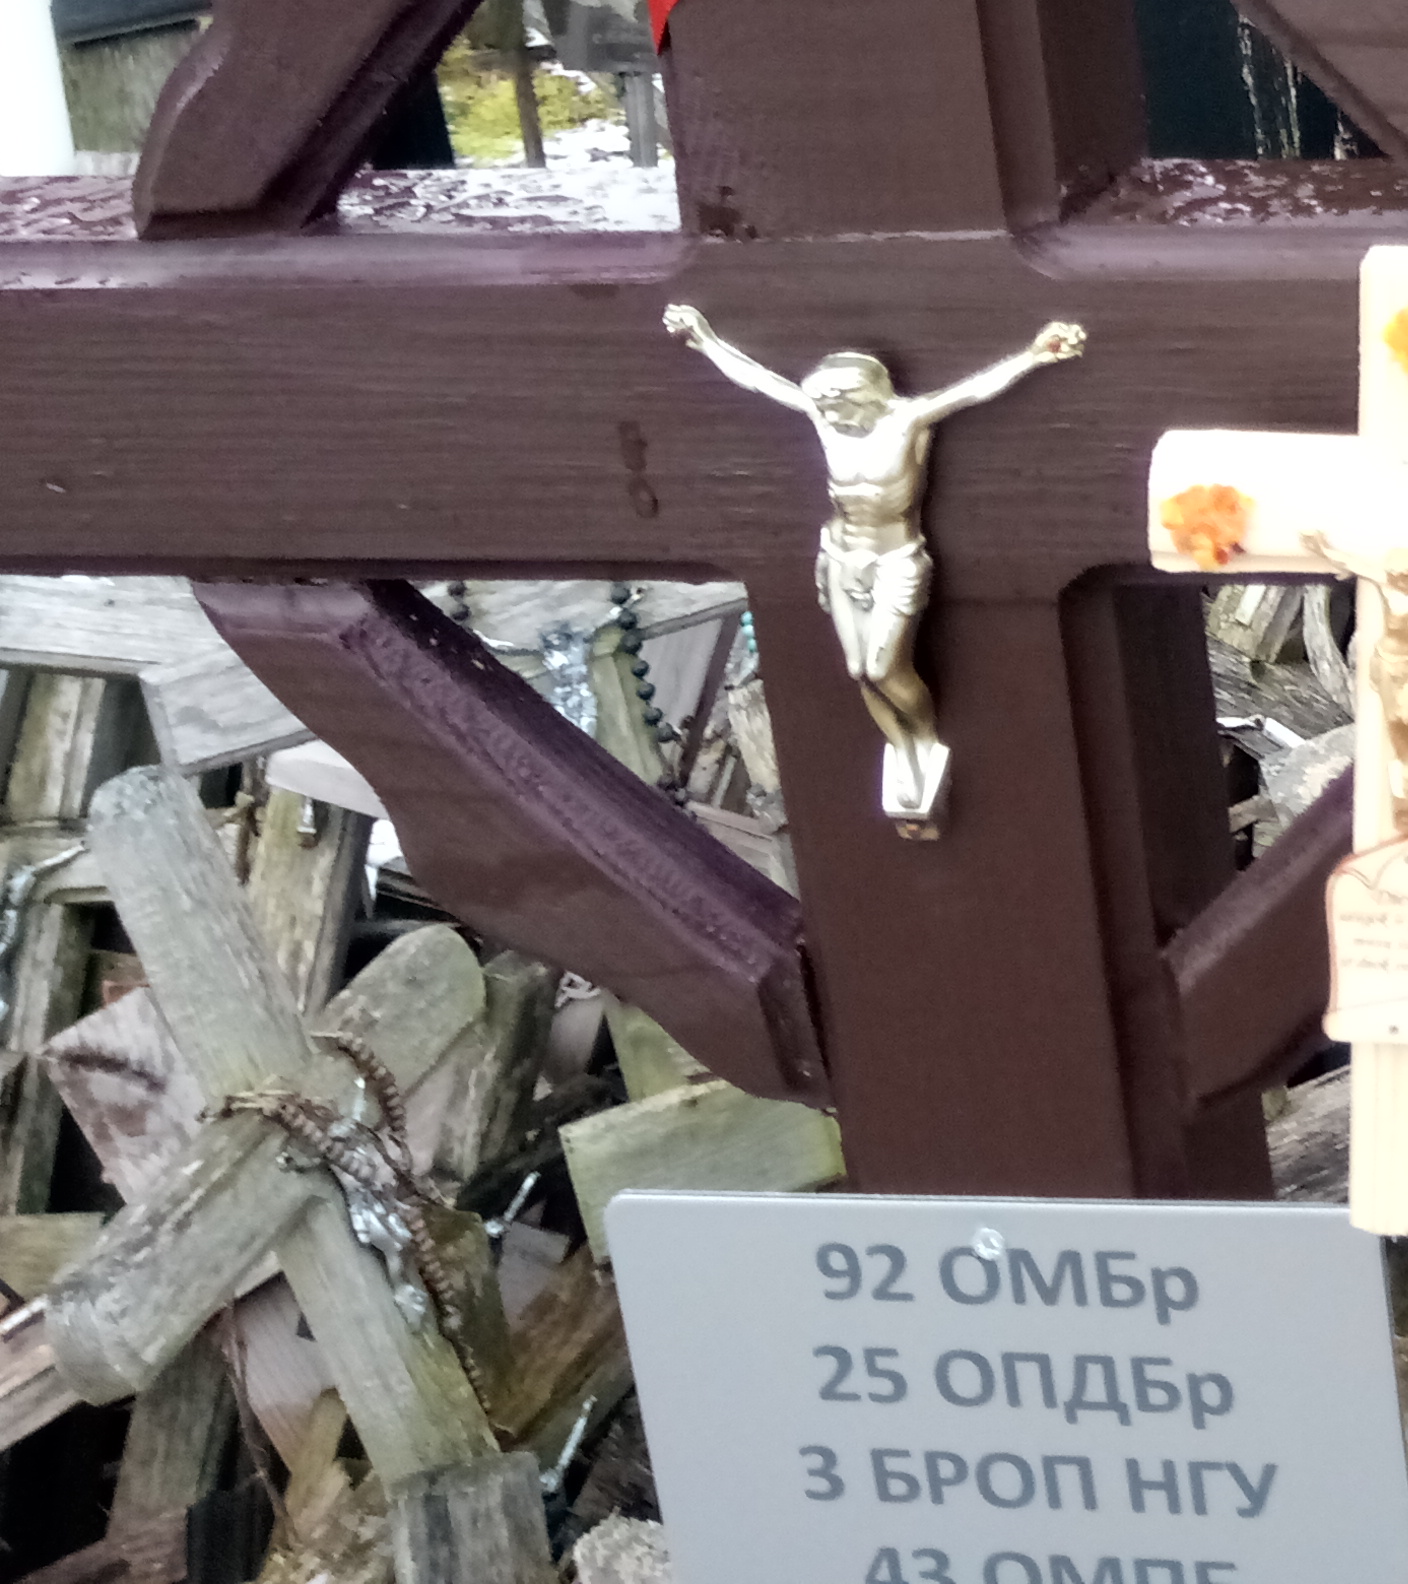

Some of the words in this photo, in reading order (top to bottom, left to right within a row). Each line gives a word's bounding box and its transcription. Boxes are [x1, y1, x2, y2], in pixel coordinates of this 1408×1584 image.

[816, 1241, 914, 1303] 92
[938, 1246, 1199, 1326] ОМБр
[813, 1344, 908, 1404] 25
[934, 1348, 1235, 1430] ОПДБр
[798, 1444, 846, 1502] 3
[869, 1447, 1098, 1512] БРОП
[1124, 1457, 1278, 1519] НГУ
[864, 1547, 957, 1584] 43
